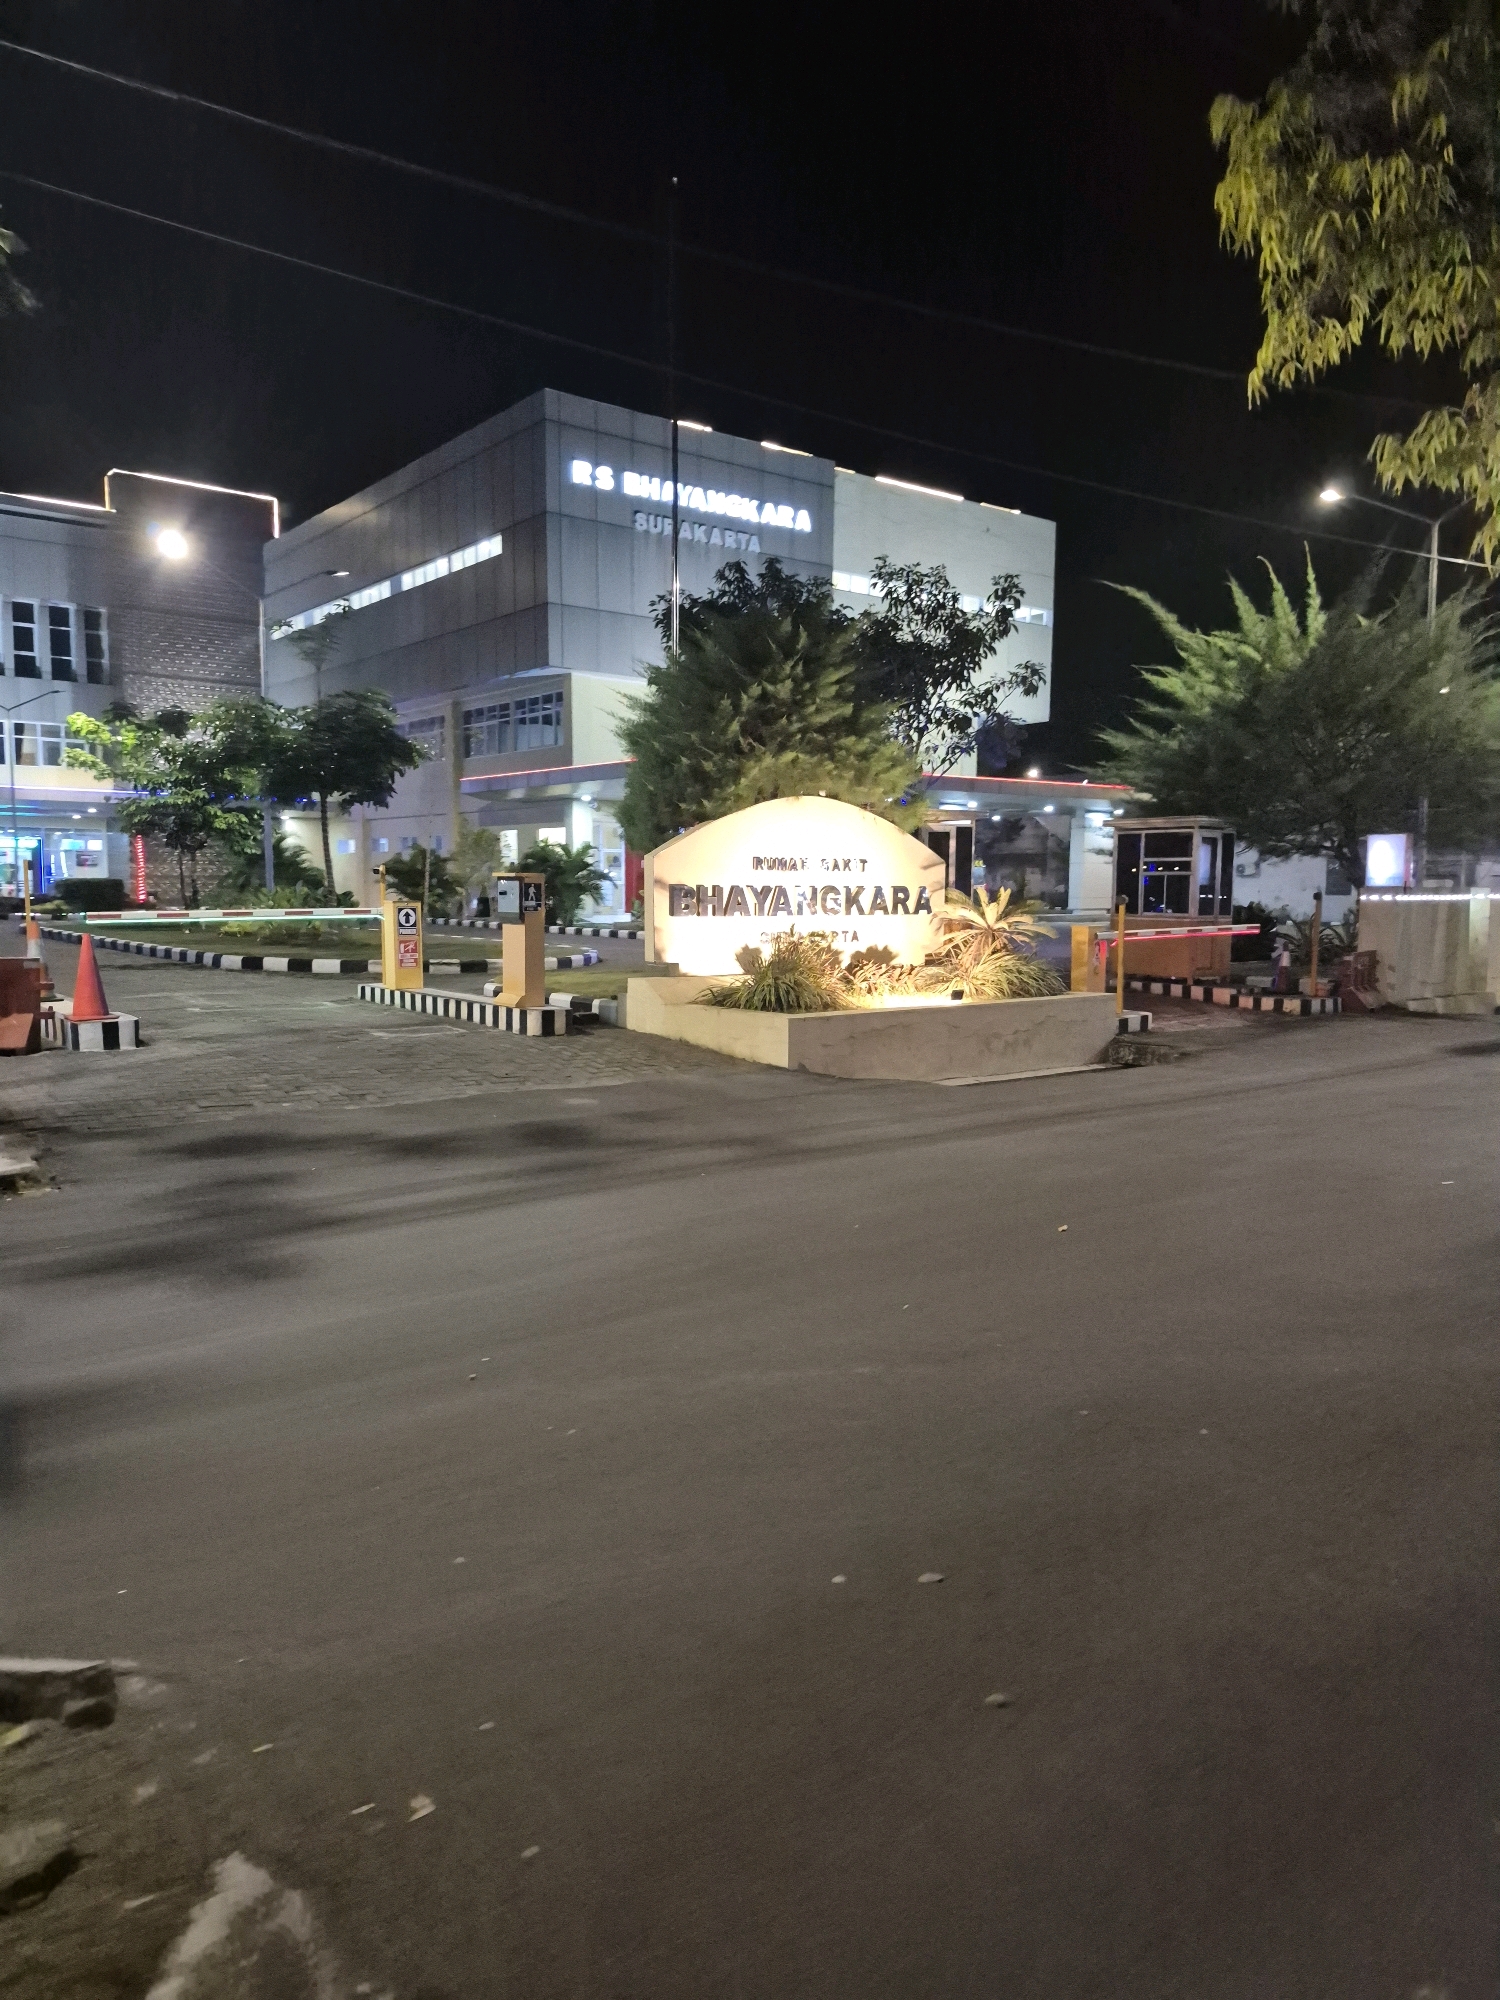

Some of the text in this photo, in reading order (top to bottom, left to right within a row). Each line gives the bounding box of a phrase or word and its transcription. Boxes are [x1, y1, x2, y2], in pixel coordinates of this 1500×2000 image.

[572, 459, 812, 533] RS BHAYANGKARA
[668, 884, 932, 917] BHAYANGKARA
